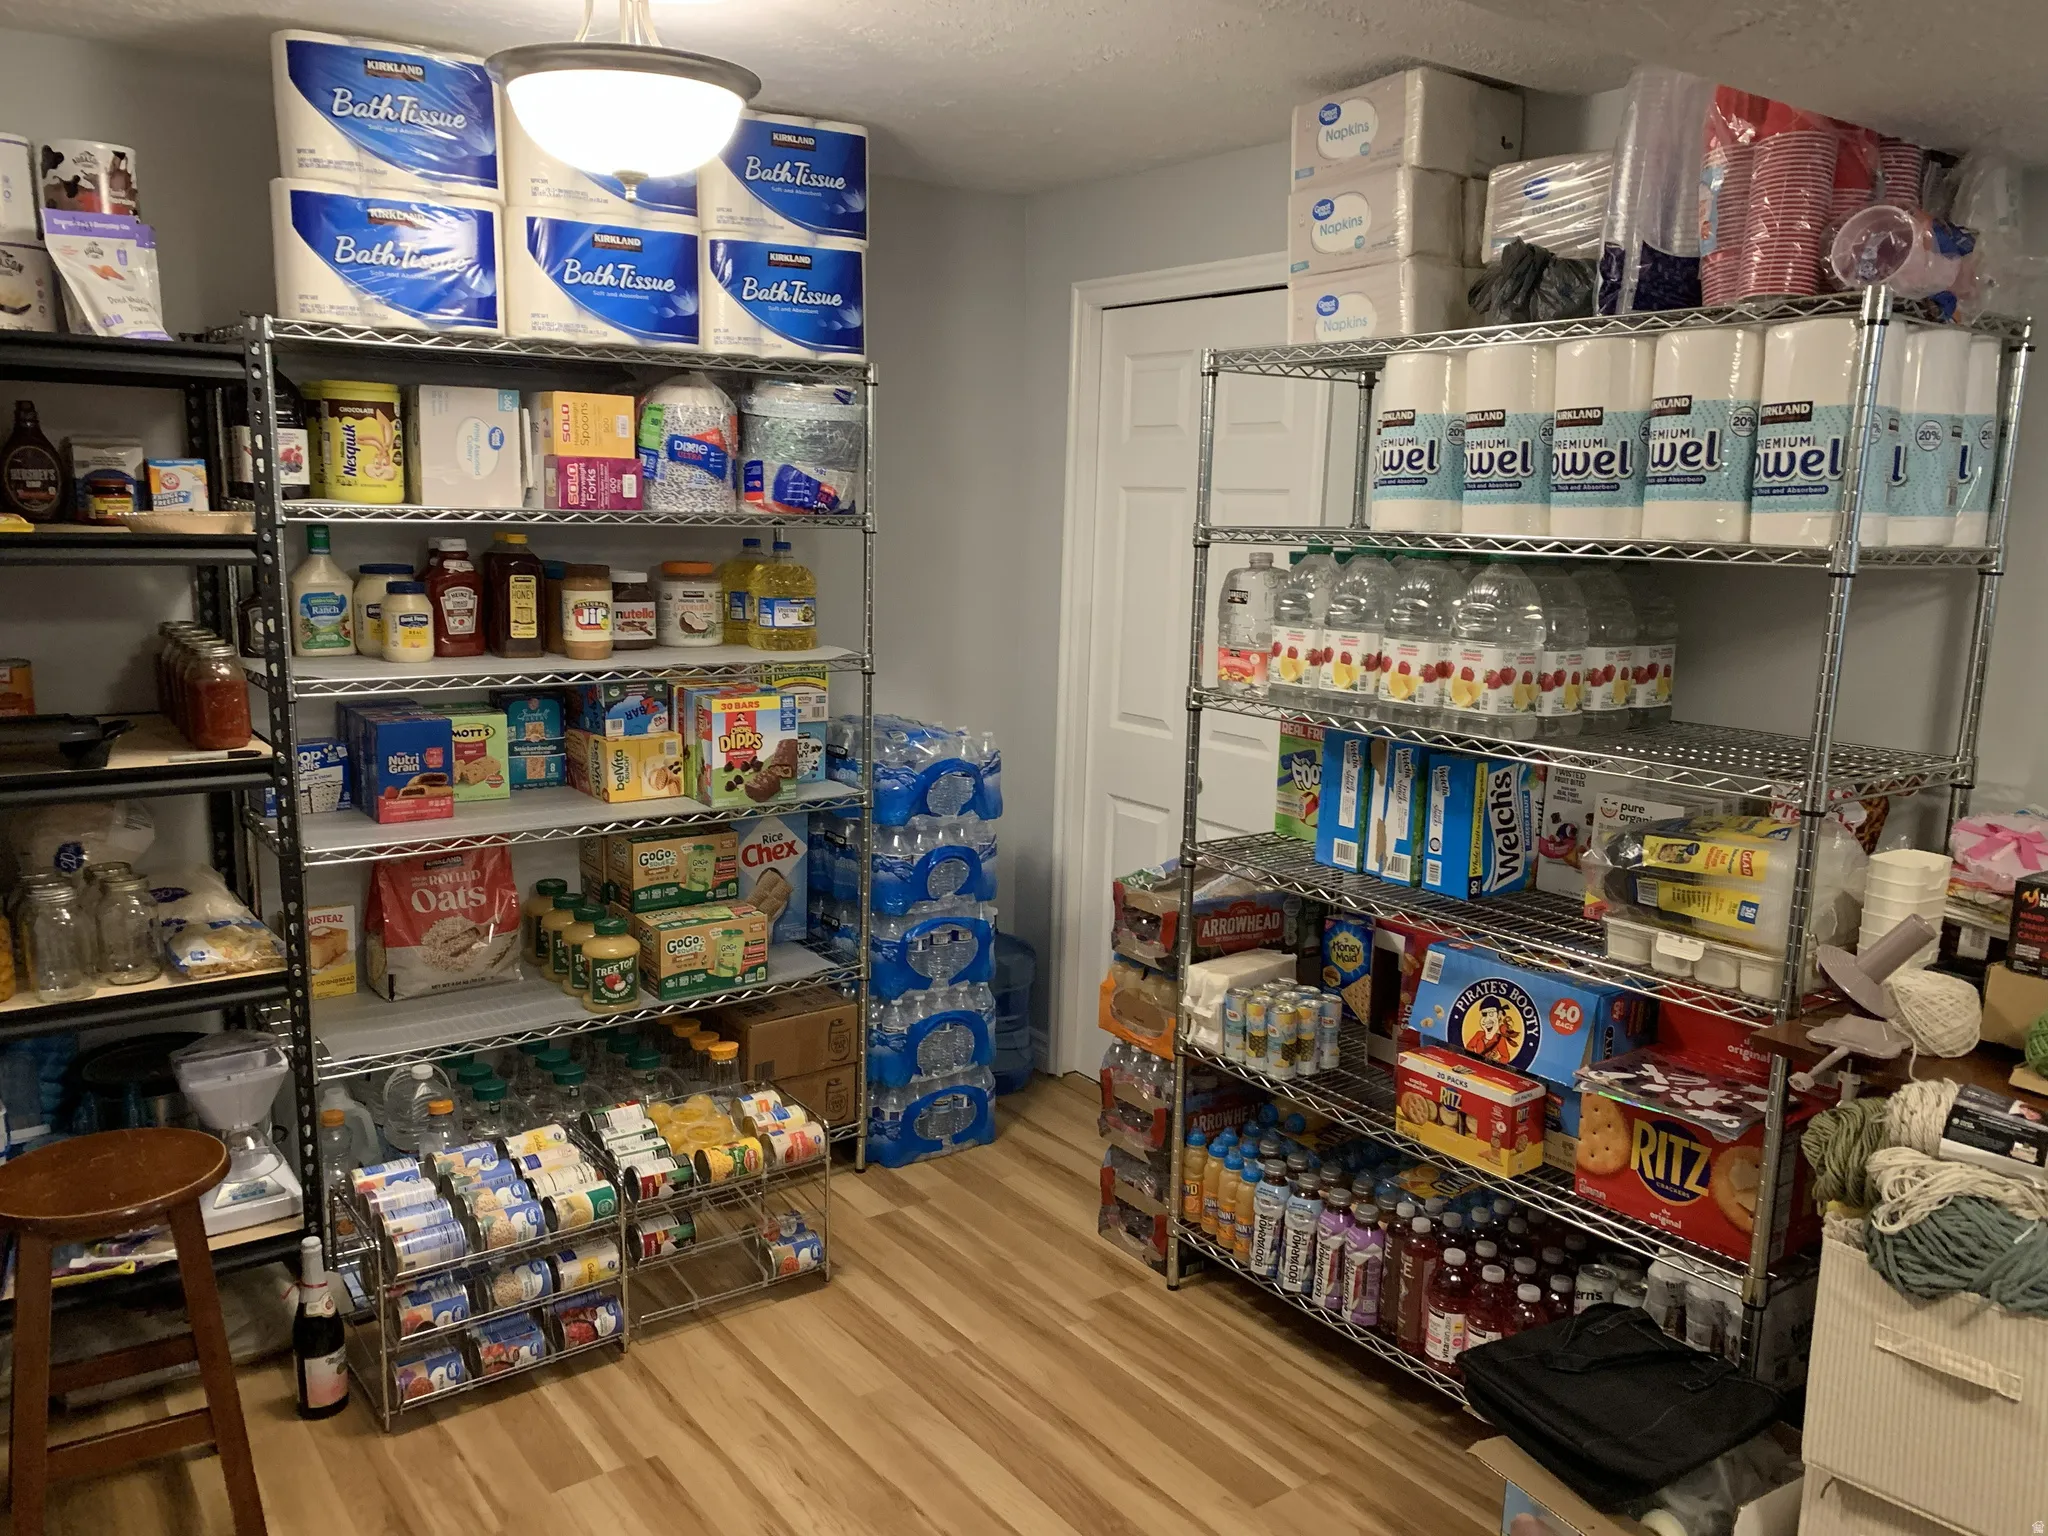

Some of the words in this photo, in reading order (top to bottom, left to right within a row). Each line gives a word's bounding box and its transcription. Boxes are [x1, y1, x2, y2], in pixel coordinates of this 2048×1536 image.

[367, 59, 424, 76] KIRKLAND
[332, 86, 401, 122] Bath
[397, 95, 467, 129] Tissue
[1319, 107, 1338, 118] Great
[772, 132, 815, 147] KIRKLAND
[1325, 121, 1370, 143] Napkins
[745, 155, 795, 183] Bath
[790, 161, 847, 190] Tissue
[1314, 203, 1331, 214] Great
[1531, 199, 1587, 217] Napkins
[1319, 215, 1363, 237] Napkins
[594, 232, 641, 247] KIRKLAND
[335, 235, 401, 269] Bath
[769, 251, 811, 266] KIRKLAND
[563, 257, 619, 287] Bath
[613, 263, 676, 292] Tissue
[742, 277, 793, 303] Bath
[787, 280, 843, 307] Tissue
[1317, 299, 1335, 308] Great
[1323, 315, 1368, 333] Napkins
[339, 406, 374, 415] CHOCOLATE
[503, 393, 513, 412] 360
[562, 404, 571, 444] SOLO
[580, 402, 591, 447] Spoons
[1732, 416, 1755, 427] 20%
[1918, 428, 1941, 442] 20%
[343, 424, 357, 477] Nesquik
[674, 440, 708, 455] DIXIE
[567, 463, 579, 506] SOLO
[579, 462, 588, 507] Heavyweight
[587, 468, 597, 502] Forks
[1786, 486, 1826, 494] Absorbent
[451, 591, 468, 599] HEINZ
[511, 589, 534, 600] HONEY
[312, 605, 340, 616] Ranch
[578, 606, 607, 625] Jif
[615, 608, 655, 620] nutella
[624, 706, 647, 722] BAR
[720, 702, 734, 711] 30
[734, 700, 760, 711] BARS
[1281, 723, 1306, 737] REAL
[514, 744, 557, 753] Snickerdoodle
[719, 733, 762, 753] DIPPS
[388, 753, 420, 768] Nutri
[1350, 740, 1358, 769] Welch's
[388, 762, 420, 775] Grain
[615, 748, 625, 792] belVita
[1402, 749, 1411, 779] Welch's
[1554, 776, 1570, 785] FRUIT
[1570, 779, 1586, 788] BITES
[1555, 768, 1587, 780] TWISTED
[1620, 802, 1645, 813] pure
[1490, 771, 1520, 885] Welch's
[1523, 819, 1531, 847] MIXED
[762, 832, 784, 844] Rice
[1473, 830, 1481, 849] Fruit
[638, 848, 671, 866] GoGo
[741, 840, 799, 868] Chex
[1472, 851, 1480, 875] Whole
[1741, 852, 1752, 875] GLAD
[429, 870, 481, 886] ROLLED
[1469, 881, 1478, 895] 90
[411, 886, 487, 915] Oats
[1745, 907, 1756, 918] 50
[1201, 911, 1280, 938] ARROWHEAD
[667, 935, 699, 953] GoGo
[1332, 941, 1361, 955] Honey
[1335, 952, 1358, 963] Maid
[595, 964, 619, 978] TREE
[618, 957, 634, 971] TOP
[1456, 980, 1507, 1012] PIRATE'S
[1510, 988, 1540, 1038] BOOTY
[1554, 1002, 1580, 1022] 40
[1555, 1019, 1574, 1031] BAGS
[1727, 1044, 1771, 1064] original
[1436, 1071, 1446, 1081] 20
[1447, 1074, 1468, 1089] PACKS
[1439, 1086, 1462, 1110] RITZ
[1516, 1106, 1531, 1123] RITZ
[1631, 1117, 1712, 1196] RITZ
[1656, 1182, 1691, 1199] CRACKERS
[1650, 1211, 1681, 1230] original
[1661, 1208, 1671, 1216] the
[1254, 1213, 1269, 1268] BODYARMOR
[1289, 1229, 1303, 1284] BODYARMOR
[1315, 1242, 1326, 1298] BODYARMOR
